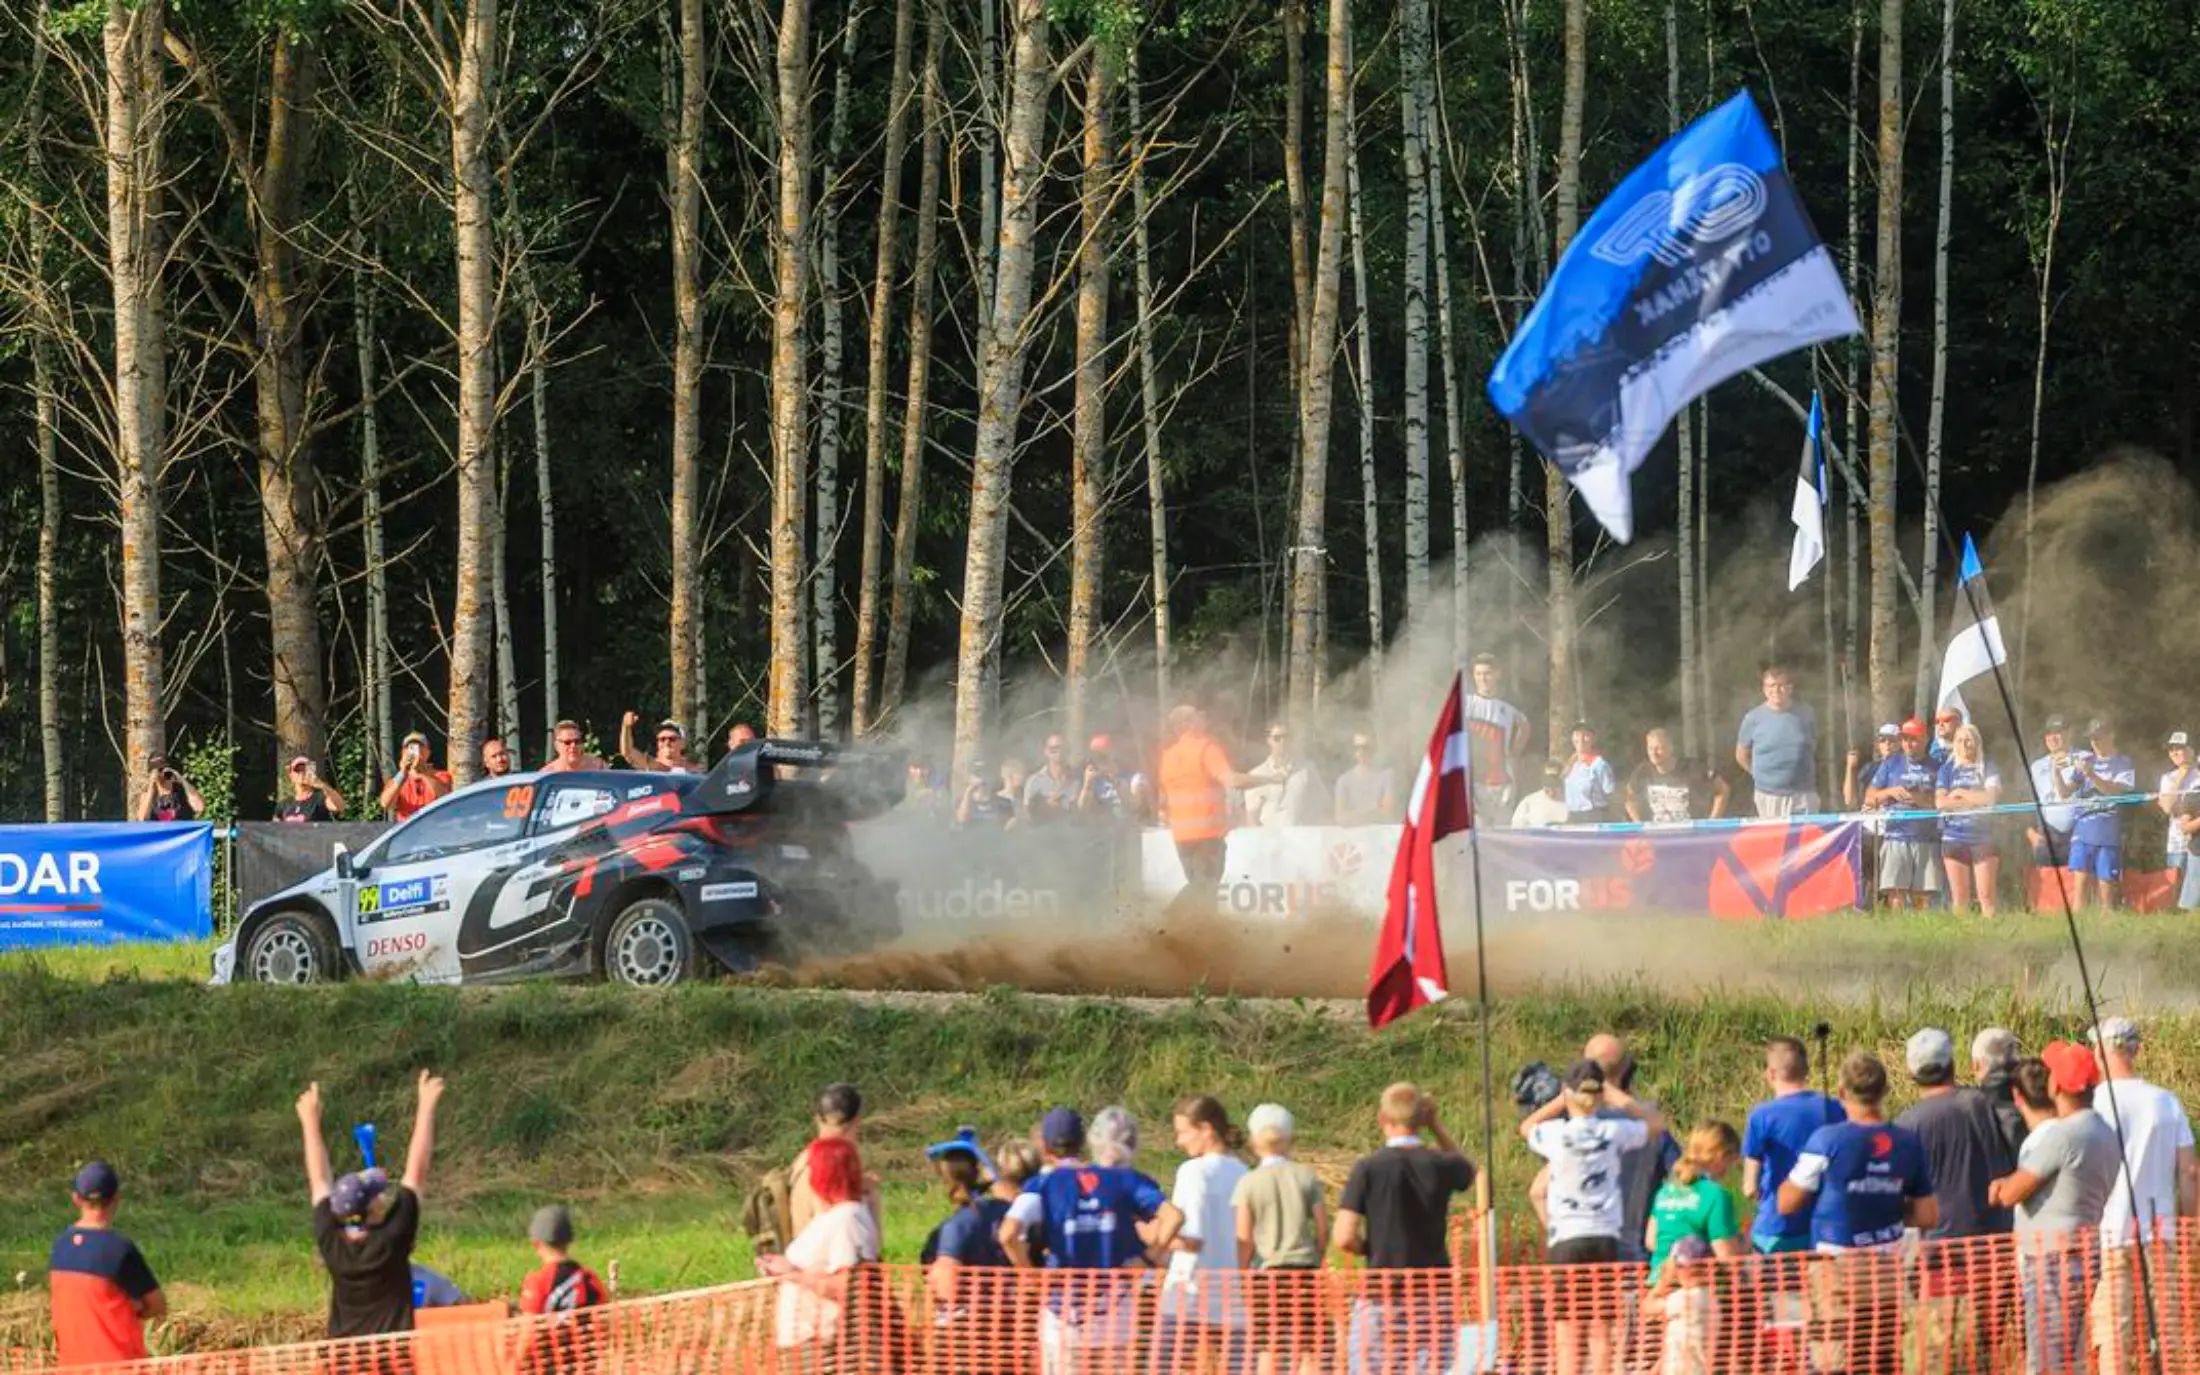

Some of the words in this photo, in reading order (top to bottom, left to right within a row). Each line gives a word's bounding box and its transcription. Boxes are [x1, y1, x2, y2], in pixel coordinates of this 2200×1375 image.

[503, 785, 534, 820] 99
[0, 852, 101, 895] DAR
[359, 885, 379, 913] 99
[388, 881, 424, 903] Delfi
[366, 932, 427, 957] DENSO
